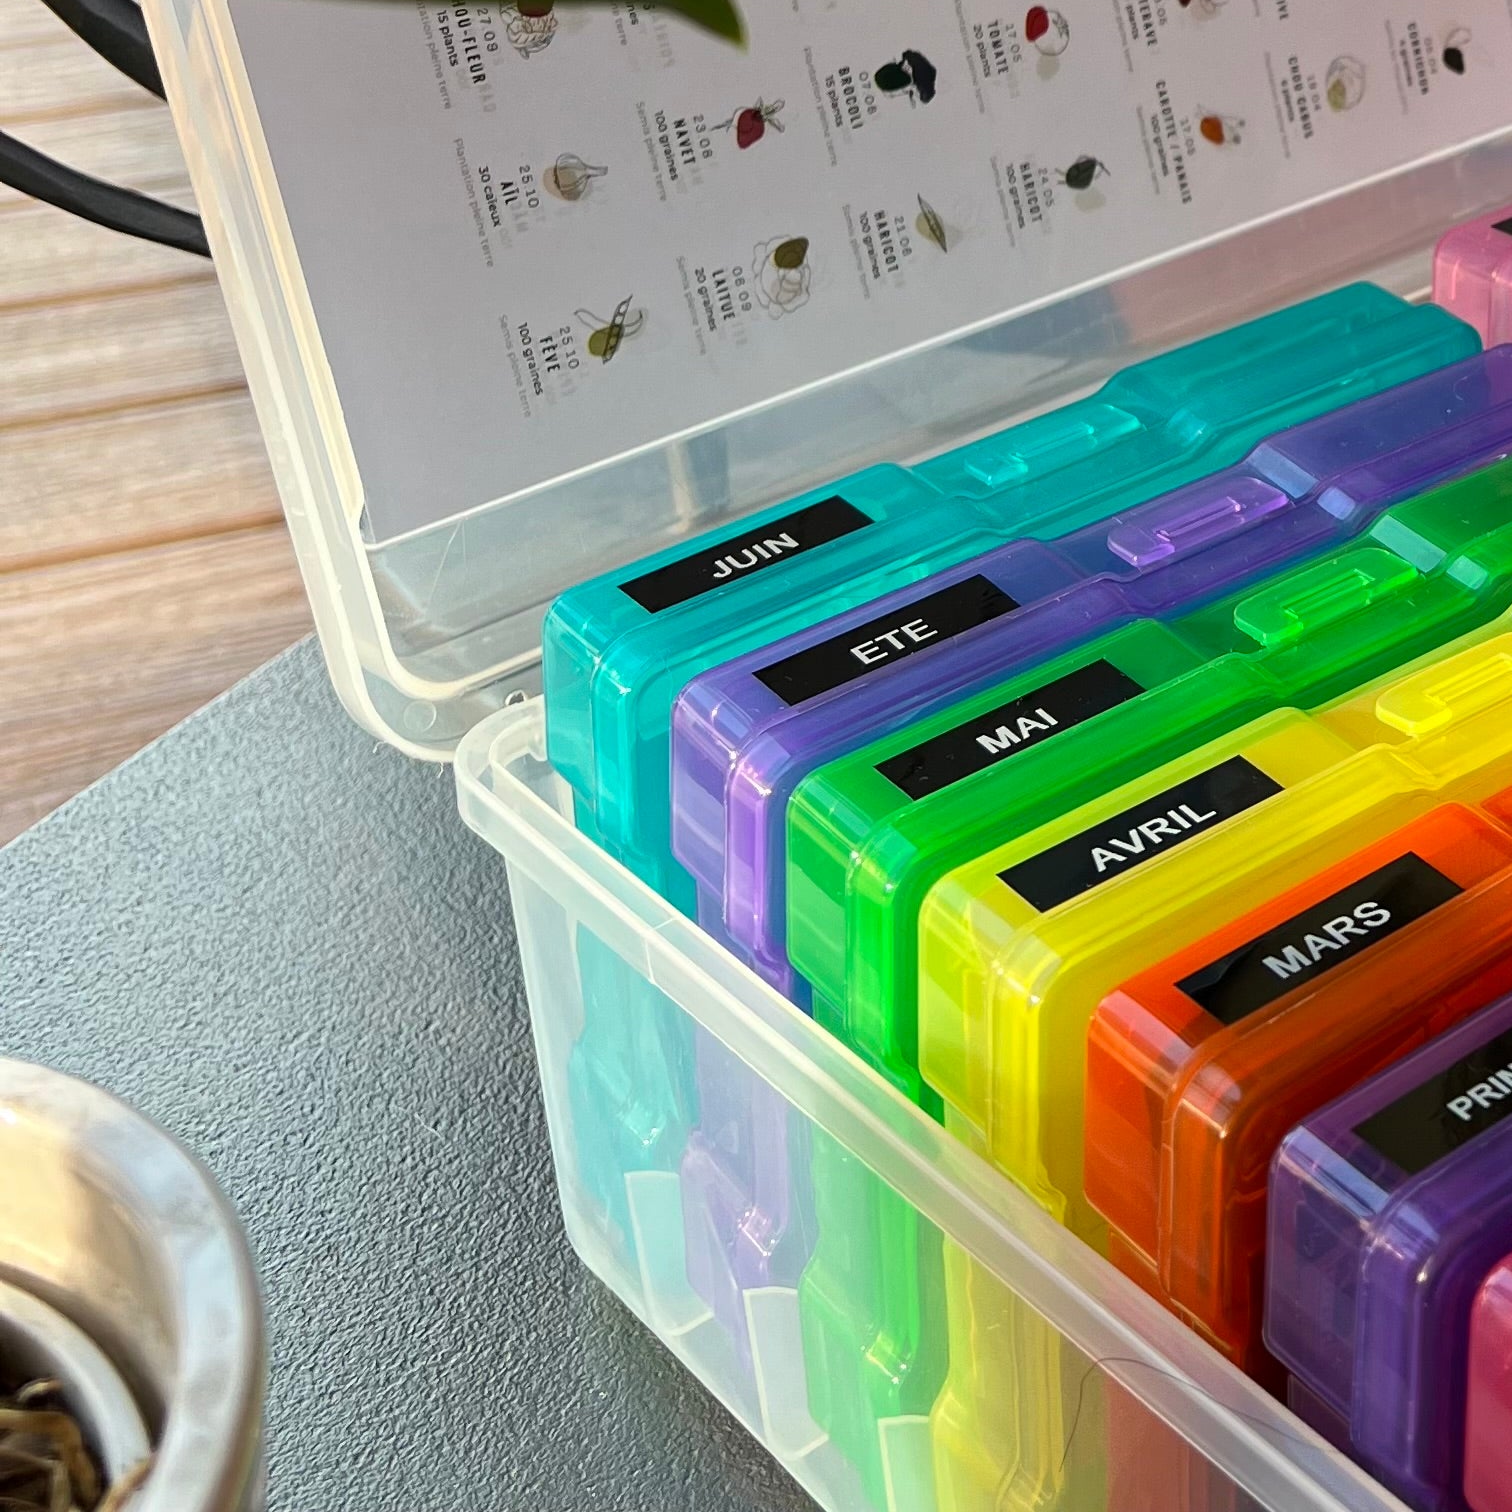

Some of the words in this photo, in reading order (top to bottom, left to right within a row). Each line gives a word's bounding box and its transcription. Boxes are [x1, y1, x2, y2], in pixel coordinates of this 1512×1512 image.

[436, 10, 450, 25] 15
[476, 8, 500, 53] 27.09
[438, 25, 460, 68] plants
[451, 0, 486, 85] HOU-FLEUR
[987, 19, 1010, 75] TOMATE
[654, 109, 669, 134] 100
[837, 65, 864, 130] BROCOLI
[657, 133, 679, 182] graines
[673, 117, 697, 165] NAVET
[691, 113, 714, 160] 23.08
[477, 165, 492, 184] 30
[518, 164, 541, 209] 25.10
[1018, 161, 1044, 223] HARICOT
[452, 136, 477, 200] Plantation
[467, 199, 487, 238] pleine
[479, 237, 495, 268] terre
[873, 209, 900, 273] HARICOT
[693, 266, 708, 285] 20
[711, 268, 736, 322] LAITUE
[730, 265, 753, 313] 06.09
[497, 313, 515, 351] Semis
[696, 285, 718, 333] graines
[517, 321, 533, 347] 100
[538, 335, 562, 374] FÈVE
[558, 325, 581, 371] 25.10
[505, 350, 525, 389] pleine
[521, 347, 545, 397] graines
[517, 387, 535, 419] terre
[711, 531, 800, 580] JUIN
[849, 618, 938, 668] ETE
[975, 707, 1060, 755] MAI
[1089, 801, 1217, 874] AVRIL
[1262, 899, 1392, 981] MARS
